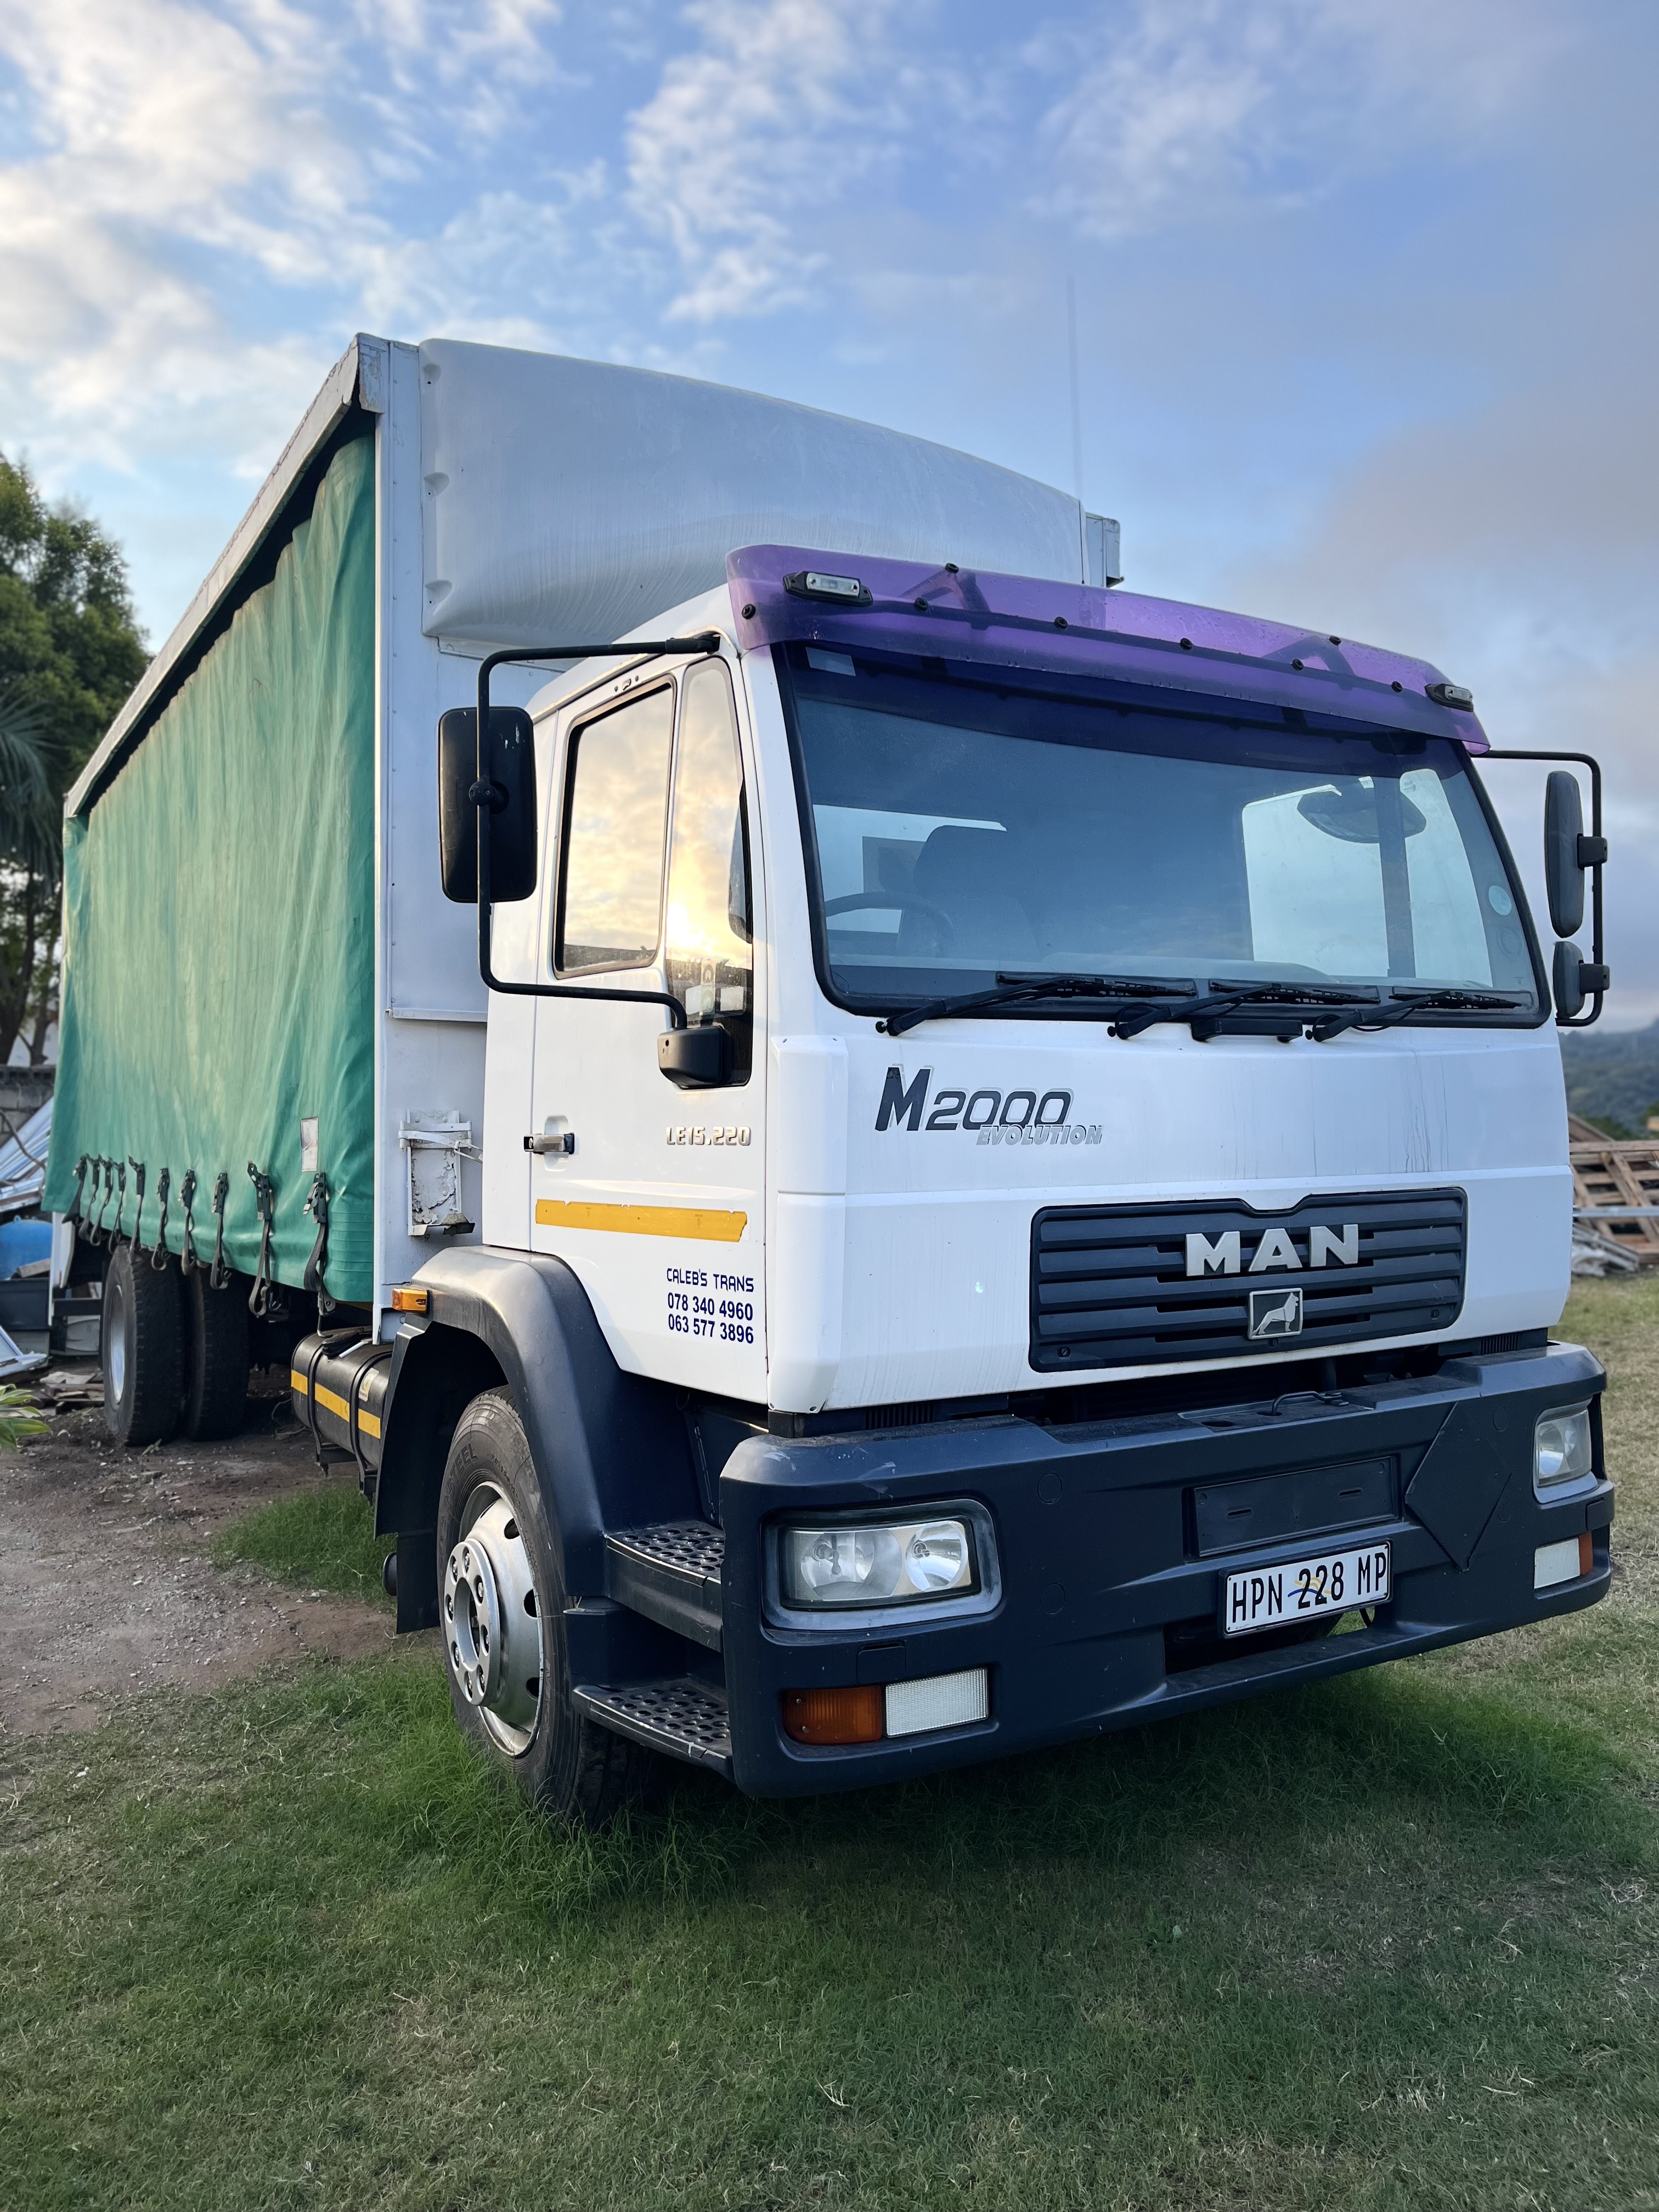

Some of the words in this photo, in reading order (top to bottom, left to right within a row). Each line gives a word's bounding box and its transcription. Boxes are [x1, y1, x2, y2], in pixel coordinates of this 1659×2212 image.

[875, 1064, 1074, 1132] M2000
[665, 1126, 752, 1146] LE15.220
[975, 1124, 1104, 1146] EVOLUTION
[1185, 1223, 1359, 1277] MAN
[667, 1267, 708, 1288] CALEB'S
[713, 1273, 755, 1293] TRANS
[667, 1292, 689, 1311] 078
[692, 1296, 715, 1316] 340
[719, 1300, 754, 1321] 4960
[668, 1313, 689, 1333] 063
[693, 1318, 715, 1338] 577
[720, 1323, 754, 1344] 3896
[1232, 1573, 1283, 1623] HPN
[1297, 1561, 1345, 1610] 228
[1357, 1552, 1387, 1596] MP
